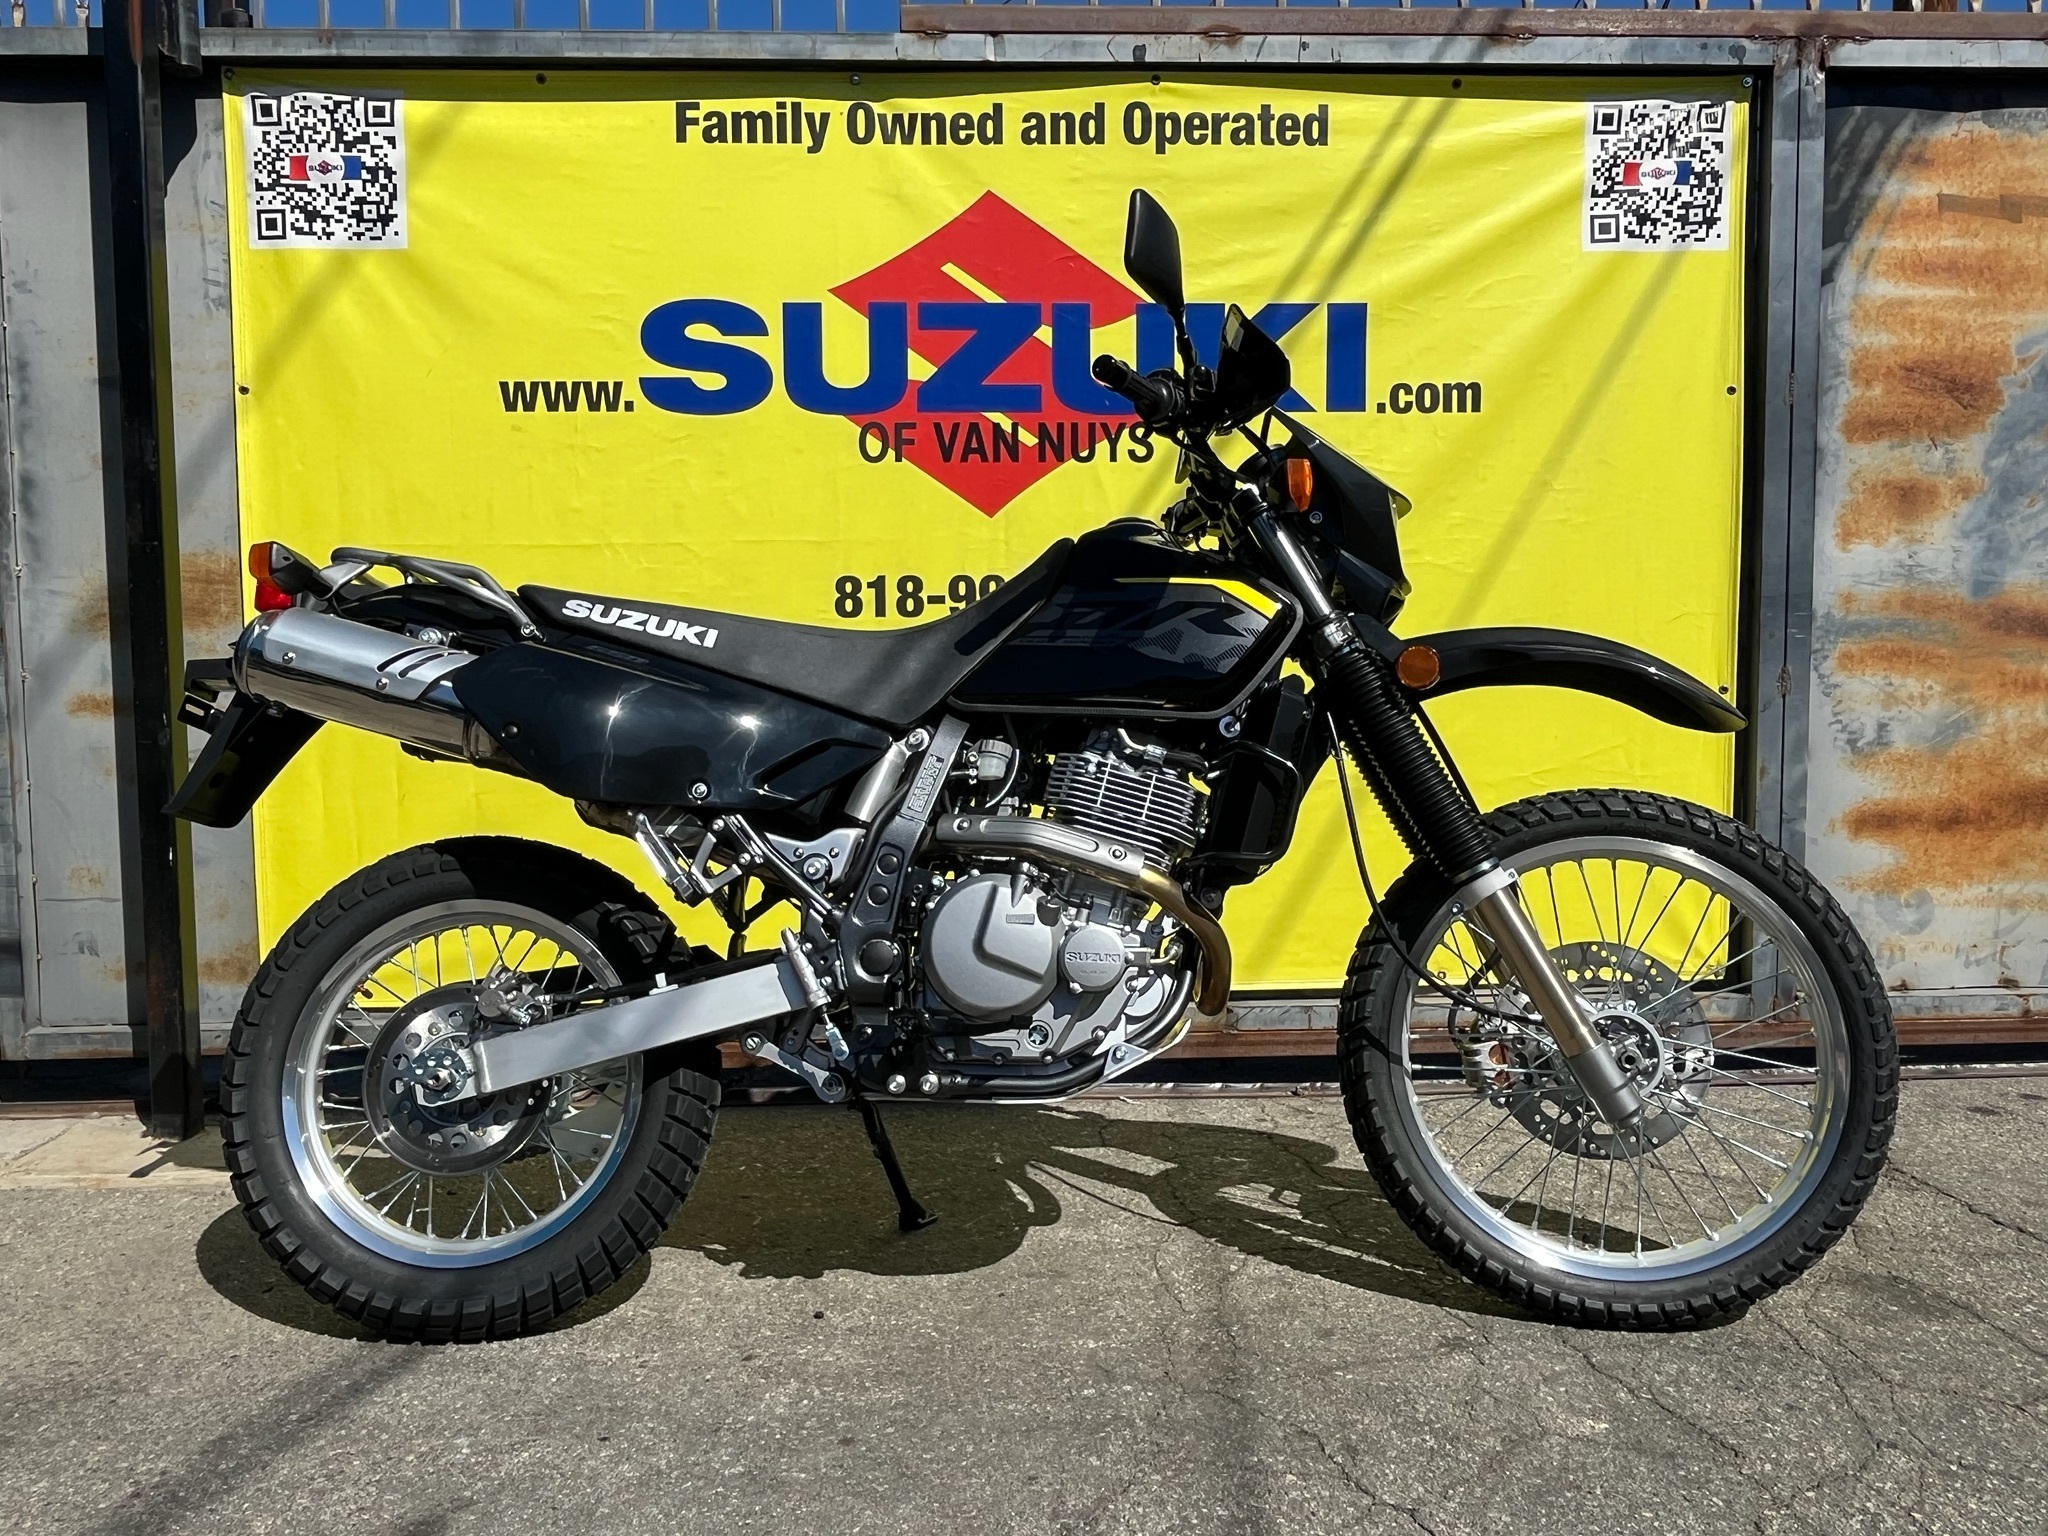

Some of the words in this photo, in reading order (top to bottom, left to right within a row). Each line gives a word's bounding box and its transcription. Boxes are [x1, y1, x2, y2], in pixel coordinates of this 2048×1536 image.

[675, 101, 831, 155] Family
[846, 102, 1004, 146] Owned
[1020, 102, 1106, 146] and
[1123, 101, 1329, 155] Operated
[858, 421, 917, 463] OF
[933, 421, 1019, 463] VAN
[1038, 421, 1154, 463] NUYS
[562, 599, 719, 648] SUZUKI
[1066, 951, 1121, 964] SUZUKI
